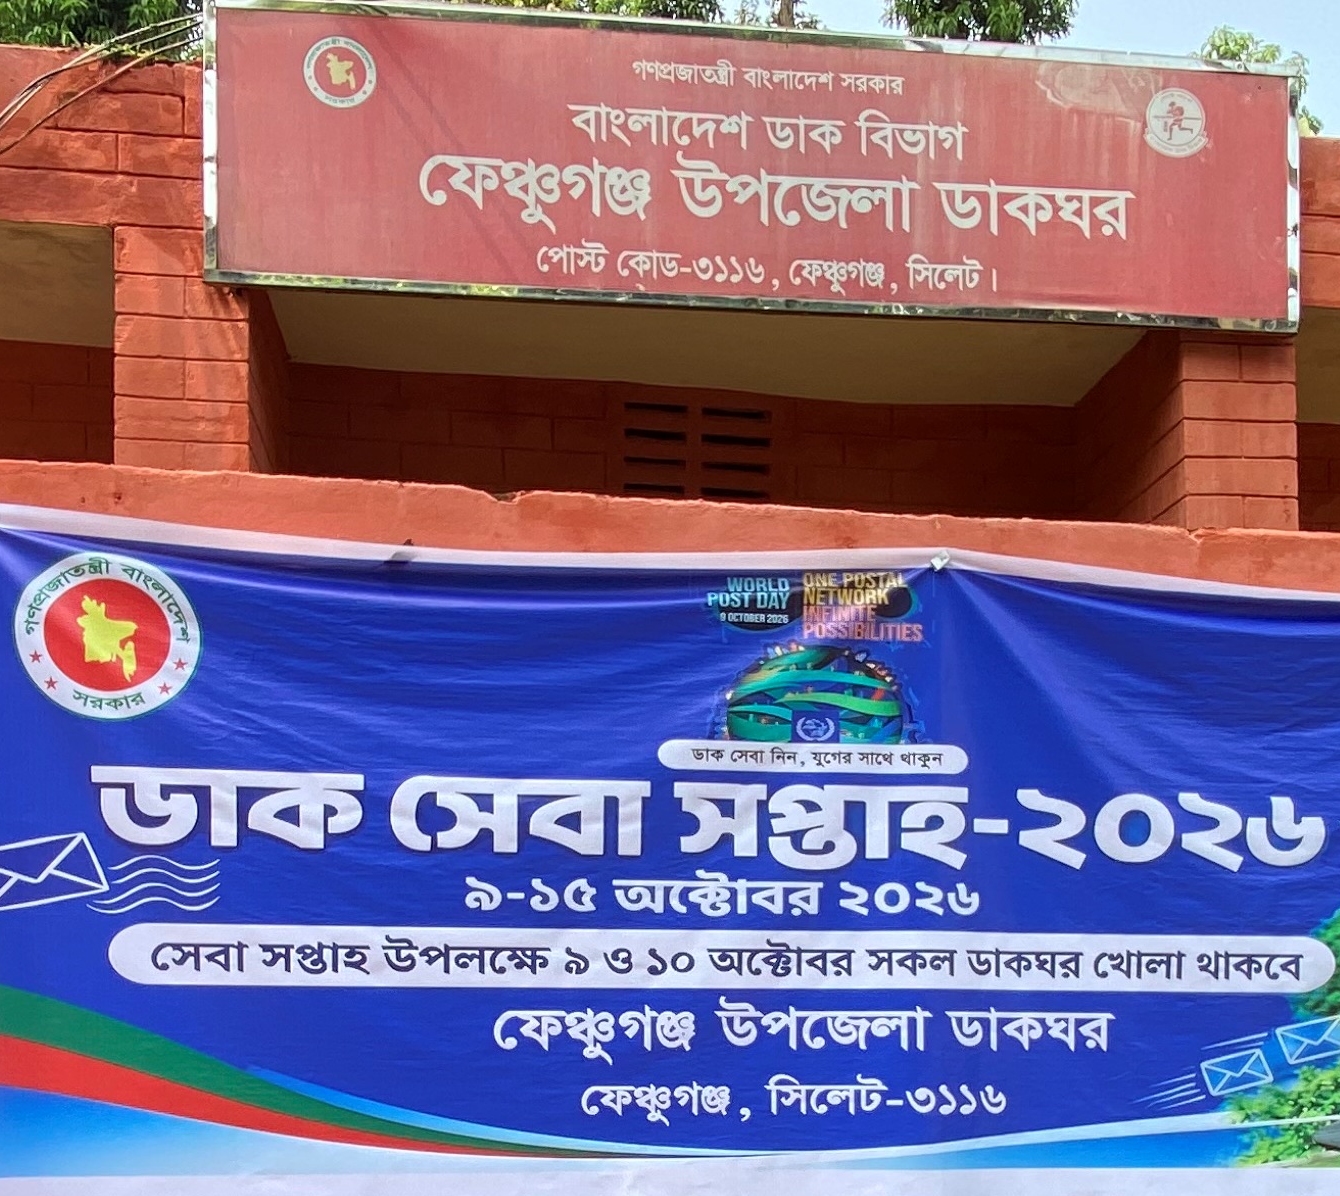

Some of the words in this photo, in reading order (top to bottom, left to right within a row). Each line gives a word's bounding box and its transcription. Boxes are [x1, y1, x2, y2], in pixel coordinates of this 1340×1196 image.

[741, 67, 834, 91] বাংলাদেশ
[839, 72, 906, 96] সরকার
[566, 102, 754, 150] বাংলাদেশ
[761, 115, 846, 155] ডাক
[854, 107, 969, 161] বিভাগ
[419, 154, 652, 235] ফেঞ্চুগঞ্জ
[670, 150, 922, 234] উপজেলা
[931, 178, 1136, 240] ডাকঘর
[536, 241, 609, 275] পোস্ট
[726, 577, 790, 592] WORLD
[802, 572, 839, 588] ONE
[842, 572, 908, 589] POSTAL
[120, 563, 191, 644] বাংলাদেশ
[707, 592, 753, 608] POST
[756, 592, 790, 610] DAY
[802, 587, 890, 606] NETWORK
[719, 612, 727, 623] 9
[728, 613, 766, 624] OCTOBER
[802, 605, 877, 623] INFINITE
[802, 622, 923, 642] POSSIBILITIES
[72, 689, 146, 711] সরকার
[691, 747, 724, 762] ডাক
[730, 749, 766, 764] সেবা
[811, 751, 854, 767] যুগের
[858, 751, 894, 767] সাথে
[901, 752, 944, 770] থাকুন
[91, 765, 364, 850] ডাক
[389, 774, 650, 856] সেবা
[673, 779, 1327, 872] সপ্তাহ-২০২৬
[465, 874, 597, 913] ৯-১৫
[613, 871, 823, 917] অক্টোবর
[839, 881, 981, 916] ২০২৬
[150, 940, 247, 973] সেবা
[259, 941, 371, 975] সপ্তাহ
[382, 934, 551, 976] উপলক্ষে
[564, 946, 590, 975] ৯
[603, 948, 634, 975] ও
[646, 948, 695, 976] ১০
[706, 938, 856, 978] অক্টোবর
[865, 949, 957, 977] সকল
[966, 947, 1084, 979] ডাকঘর
[1093, 949, 1187, 980] খোলা
[1196, 951, 1303, 982] থাকবে
[493, 1004, 696, 1066] ফেঞ্চুগঞ্জ
[715, 994, 934, 1052] উপজেলা
[946, 1006, 1116, 1052] ডাকঘর
[764, 1073, 1008, 1116] সিলেট-৩১১৬
